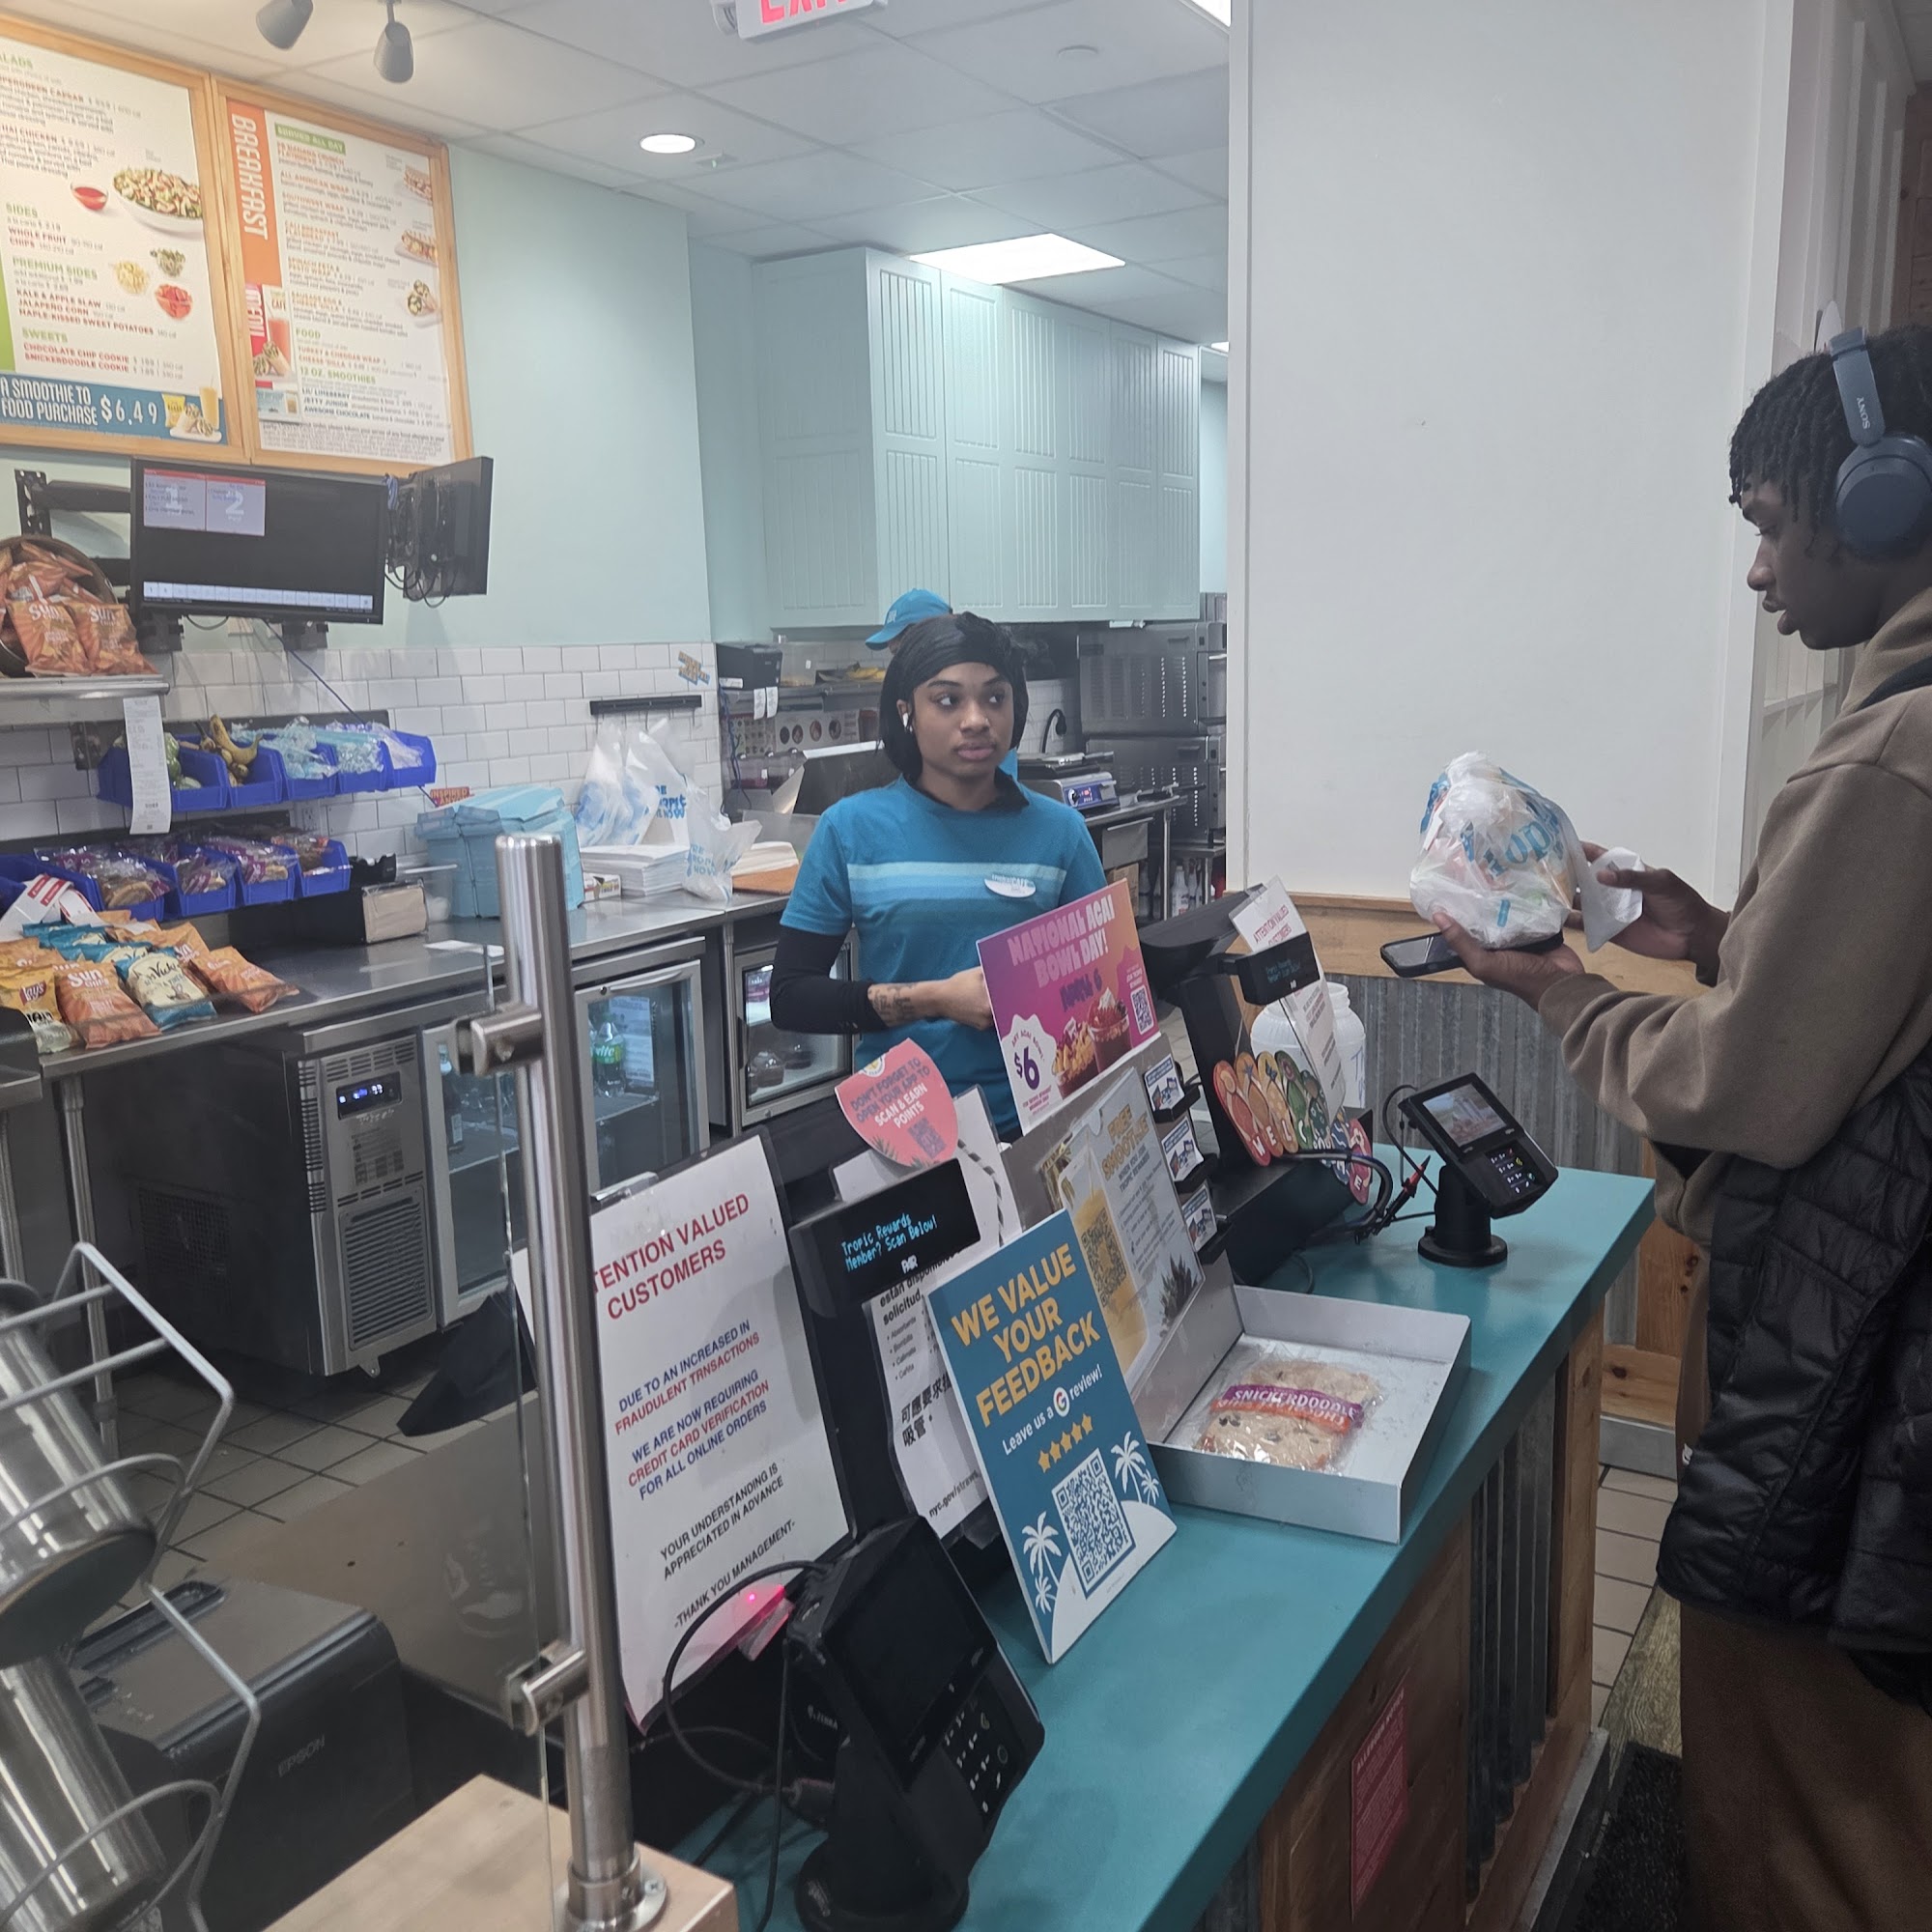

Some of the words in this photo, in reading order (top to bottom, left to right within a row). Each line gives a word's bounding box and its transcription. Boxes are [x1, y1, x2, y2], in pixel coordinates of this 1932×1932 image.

[232, 113, 269, 240] BREAKFAST
[6, 203, 38, 218] SIDES
[8, 226, 41, 240] WHOLE
[42, 231, 68, 243] FRUIT
[10, 237, 36, 248] CHIPS
[13, 256, 64, 274] PREMIUM
[67, 266, 98, 280] SIDES
[49, 293, 75, 304] APPLE
[65, 306, 90, 317] CORN
[22, 327, 69, 343] SWEETS
[83, 317, 111, 329] SWEET
[113, 322, 155, 335] POTATOES
[296, 328, 321, 340] FOOD
[23, 342, 75, 357] CHOCOLATE
[77, 348, 97, 359] CHIP
[98, 351, 129, 364] COOKIE
[24, 353, 97, 370] SNICKERDOODLE
[98, 361, 129, 373] COOKIE
[0, 376, 10, 391] A
[12, 377, 74, 404] SMOOTHIE
[75, 384, 92, 407] TO
[327, 370, 377, 384] SMOOTHIES
[1, 396, 35, 420] FOOD
[36, 400, 99, 427] PURCHASE
[1856, 396, 1871, 431] SONY
[225, 490, 244, 515] 2
[88, 604, 116, 622] Sun
[1007, 908, 1087, 966] NATIONAL
[1253, 919, 1276, 944] ATTENTION
[1034, 944, 1083, 989] BOWL
[1080, 927, 1109, 966] DAY!
[67, 969, 104, 988] Sun
[876, 1067, 909, 1095] FORGET
[906, 1057, 923, 1074] TO
[1014, 1046, 1040, 1090] $6
[856, 1102, 880, 1123] OPEN
[879, 1088, 903, 1107] YOUR
[900, 1073, 919, 1094] APP
[917, 1065, 931, 1080] TO
[898, 1098, 907, 1110] &
[902, 1082, 928, 1105] EARN
[874, 1106, 900, 1127] SCAN
[894, 1101, 925, 1129] POINTS
[1101, 1113, 1150, 1182] SMOOTE
[593, 1233, 675, 1294] ENTION
[675, 1193, 751, 1246] VALUED
[840, 1231, 874, 1256] Tropic
[874, 1211, 912, 1240] Rewards
[844, 1239, 883, 1273] Member?
[885, 1232, 908, 1252] Scan
[908, 1213, 938, 1240] Below!
[608, 1238, 726, 1320] CUSTOMERS
[951, 1293, 1001, 1348] WE
[996, 1242, 1078, 1315] VALUE
[992, 1296, 1064, 1365] YOUR
[614, 1378, 689, 1436] FRAUDULENT
[689, 1331, 761, 1386] TRNSACTIONS
[618, 1388, 643, 1413] DUE
[643, 1377, 662, 1397] TO
[663, 1364, 679, 1386] AN
[679, 1326, 740, 1375] INCREASED
[739, 1319, 752, 1336] IN
[975, 1310, 1101, 1429] FEEDBACK
[631, 1444, 652, 1464] WE
[652, 1425, 676, 1451] ARE
[676, 1408, 703, 1435] NOW
[703, 1369, 760, 1416] REQUIRING
[1002, 1425, 1034, 1457] Leave
[1033, 1412, 1047, 1431] us
[1046, 1406, 1055, 1417] a
[1056, 1391, 1067, 1412] G
[1068, 1363, 1104, 1402] review!
[627, 1448, 668, 1489] CREDIT
[669, 1427, 701, 1458] CARD
[700, 1379, 771, 1435] VERIFICATION
[638, 1473, 664, 1501] FOR
[665, 1457, 687, 1482] ALL
[686, 1429, 726, 1466] ONLINE
[725, 1399, 768, 1437] ORDERS
[928, 1469, 979, 1519] nyc.gov/straws
[659, 1530, 692, 1563] YOUR
[691, 1467, 769, 1539] UNDERSTANDING
[768, 1461, 780, 1478] IS
[663, 1518, 730, 1582] APPRECIATED
[730, 1509, 743, 1527] IN
[742, 1474, 784, 1519] ADVANCE
[709, 1573, 732, 1598] YOU
